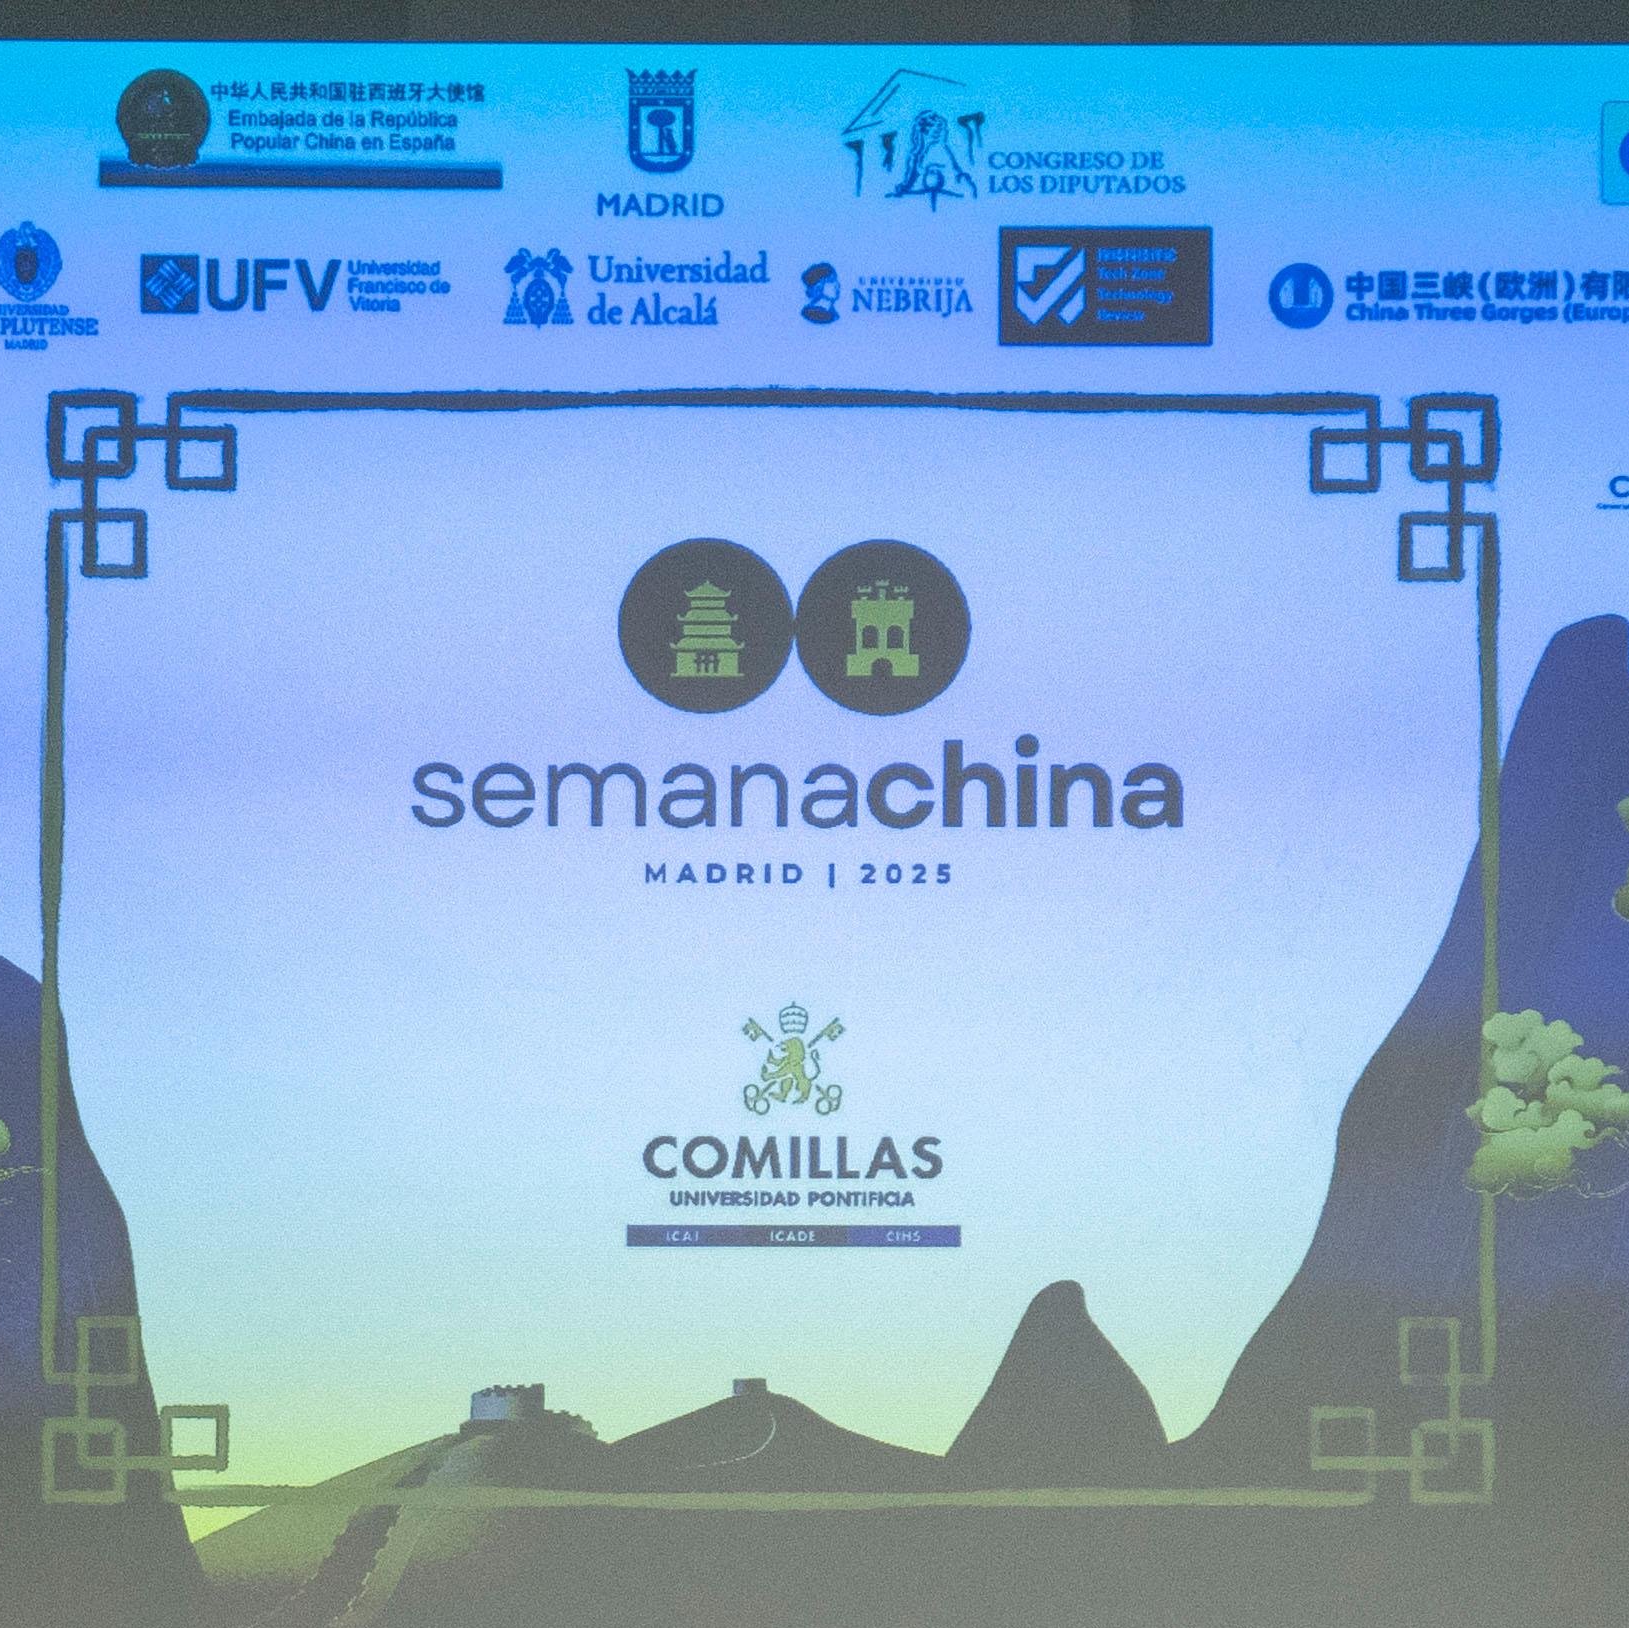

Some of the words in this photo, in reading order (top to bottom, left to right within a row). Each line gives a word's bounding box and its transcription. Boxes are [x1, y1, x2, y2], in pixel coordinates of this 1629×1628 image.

[210, 81, 485, 103] 中华人民共和国驻西班牙大使馆
[228, 109, 315, 131] Embajada
[322, 110, 345, 128] de
[349, 110, 366, 128] la
[371, 109, 458, 130] República
[231, 133, 299, 153] Popular
[305, 132, 356, 151] China
[361, 136, 384, 151] en
[389, 132, 455, 154] España
[988, 150, 1124, 171] CONGRESO
[1132, 151, 1165, 170] DE
[988, 174, 1033, 195] LOS
[1040, 174, 1186, 195] DIPUTADOS
[596, 193, 724, 218] MADRID
[347, 259, 441, 276] Universidad
[588, 250, 770, 284] Universidad
[206, 258, 343, 312] UFV
[347, 278, 426, 294] Francisco
[429, 278, 451, 295] de
[349, 295, 402, 312] Vitoria
[587, 293, 623, 326] de
[629, 292, 719, 326] Alcalá
[852, 288, 973, 318] NEBRIJA
[1345, 304, 1409, 322] China
[1414, 303, 1476, 322] Three
[1481, 303, 1558, 325] Gorges
[3, 338, 49, 351] MADRID
[411, 733, 1186, 830] semanachina
[644, 862, 804, 886] MADRID
[860, 862, 954, 886] 2025
[642, 1135, 944, 1180] COMILLAS
[669, 1190, 800, 1208] UNIVERSIDAD
[807, 1190, 915, 1208] PONTIFICIA
[770, 1230, 816, 1243] ICADE
